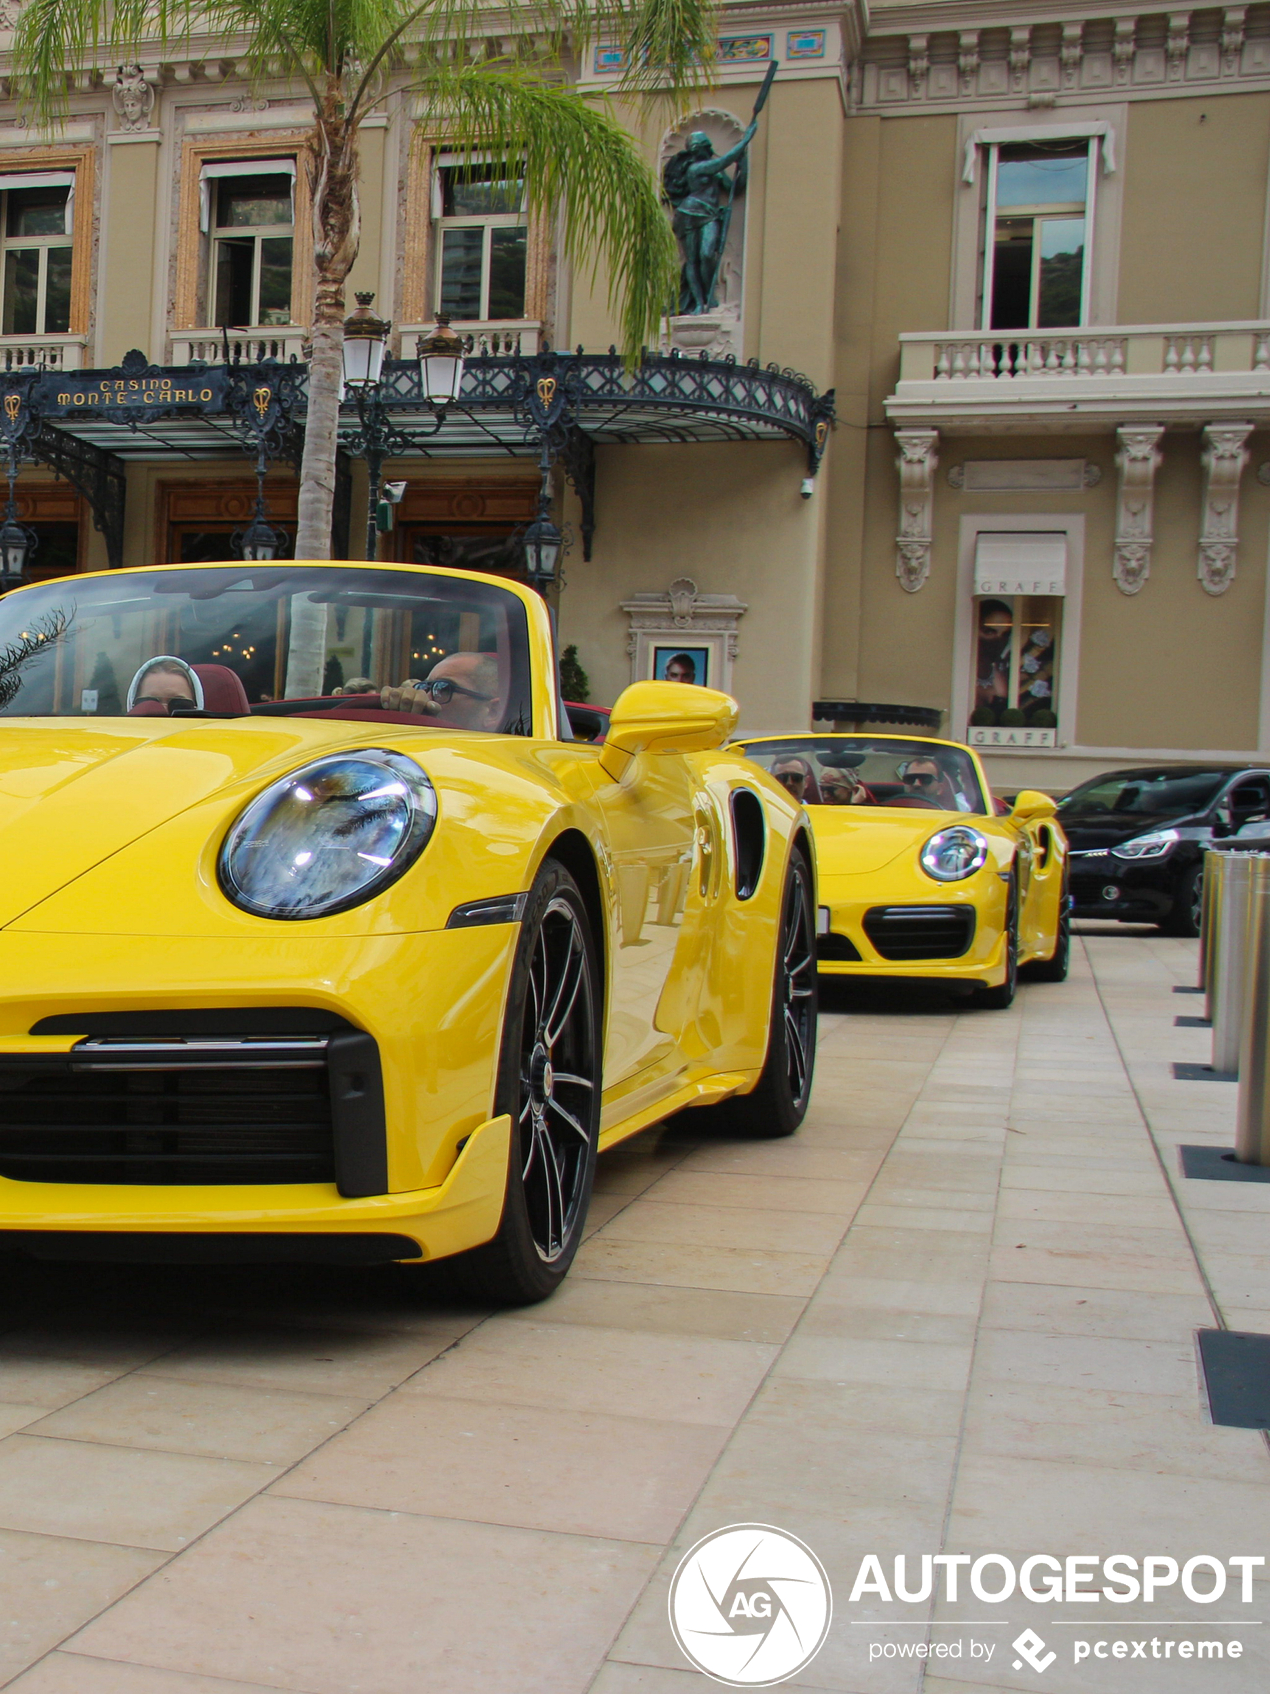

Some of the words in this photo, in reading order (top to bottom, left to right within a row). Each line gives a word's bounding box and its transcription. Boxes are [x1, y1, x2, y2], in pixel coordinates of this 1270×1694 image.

[99, 378, 172, 392] CASINO
[57, 388, 213, 406] MONTE-CARLO
[980, 581, 1057, 593] GRAFF
[974, 731, 1048, 744] GRAFF
